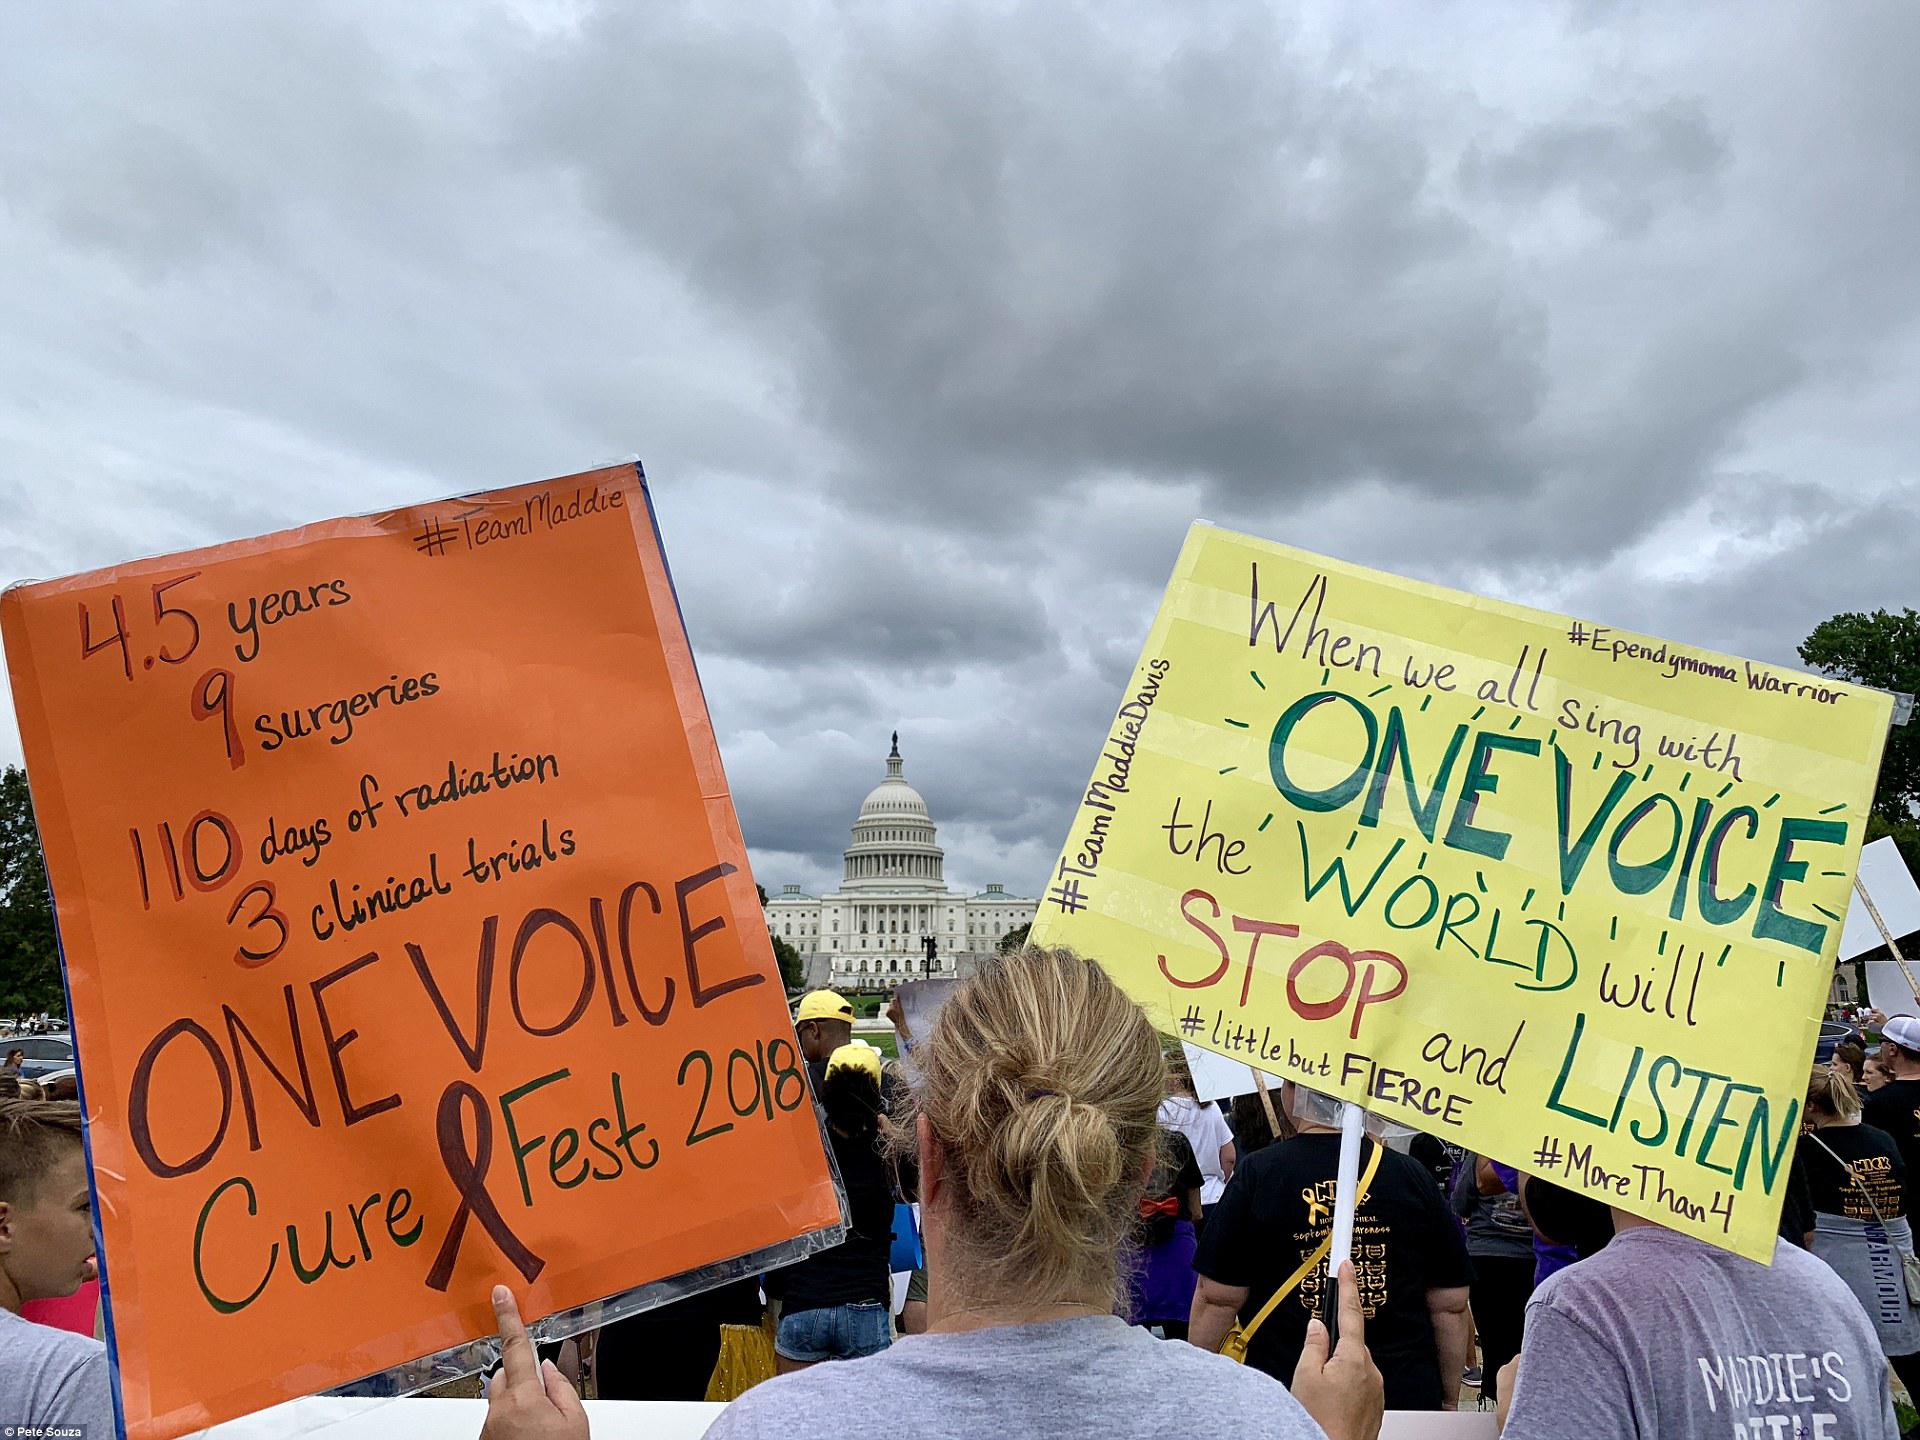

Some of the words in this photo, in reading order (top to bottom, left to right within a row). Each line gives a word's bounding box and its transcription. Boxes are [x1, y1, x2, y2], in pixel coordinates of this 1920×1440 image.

[414, 488, 624, 556] #TeamMaddie
[79, 572, 201, 681] 4.5
[228, 578, 352, 662] years
[1249, 562, 1380, 677] When
[1404, 655, 1457, 692] we
[1477, 645, 1548, 711] all
[1558, 699, 1642, 768] sing
[1658, 733, 1743, 782] with
[1745, 661, 1848, 705] Warrior
[191, 668, 244, 769] 9
[255, 668, 440, 751] surgeries
[130, 808, 243, 910] 110
[260, 817, 332, 866] days
[348, 776, 384, 833] of
[395, 749, 559, 816] radiation
[1269, 690, 1541, 860] ONE
[1554, 741, 1848, 954] VOICE
[226, 880, 290, 969] 3
[312, 853, 451, 942] clinical
[463, 819, 577, 885] trials
[1162, 797, 1252, 875] the
[1297, 820, 1578, 991] WORLD
[1600, 944, 1704, 1026] will
[128, 951, 402, 1178] ONE
[404, 863, 765, 1073] VOICE
[1158, 889, 1408, 1039] STOP
[1422, 1019, 1526, 1095] and
[1546, 1013, 1798, 1196] LISTEN
[1340, 1052, 1473, 1126] FIERCE
[193, 1177, 425, 1313] Cure
[499, 1068, 660, 1207] Fest
[678, 1038, 805, 1146] 2018
[1533, 1135, 1735, 1234] #MoreThan4
[1853, 1157, 1891, 1172] NICK
[1697, 1351, 1852, 1413] MADDIE'S
